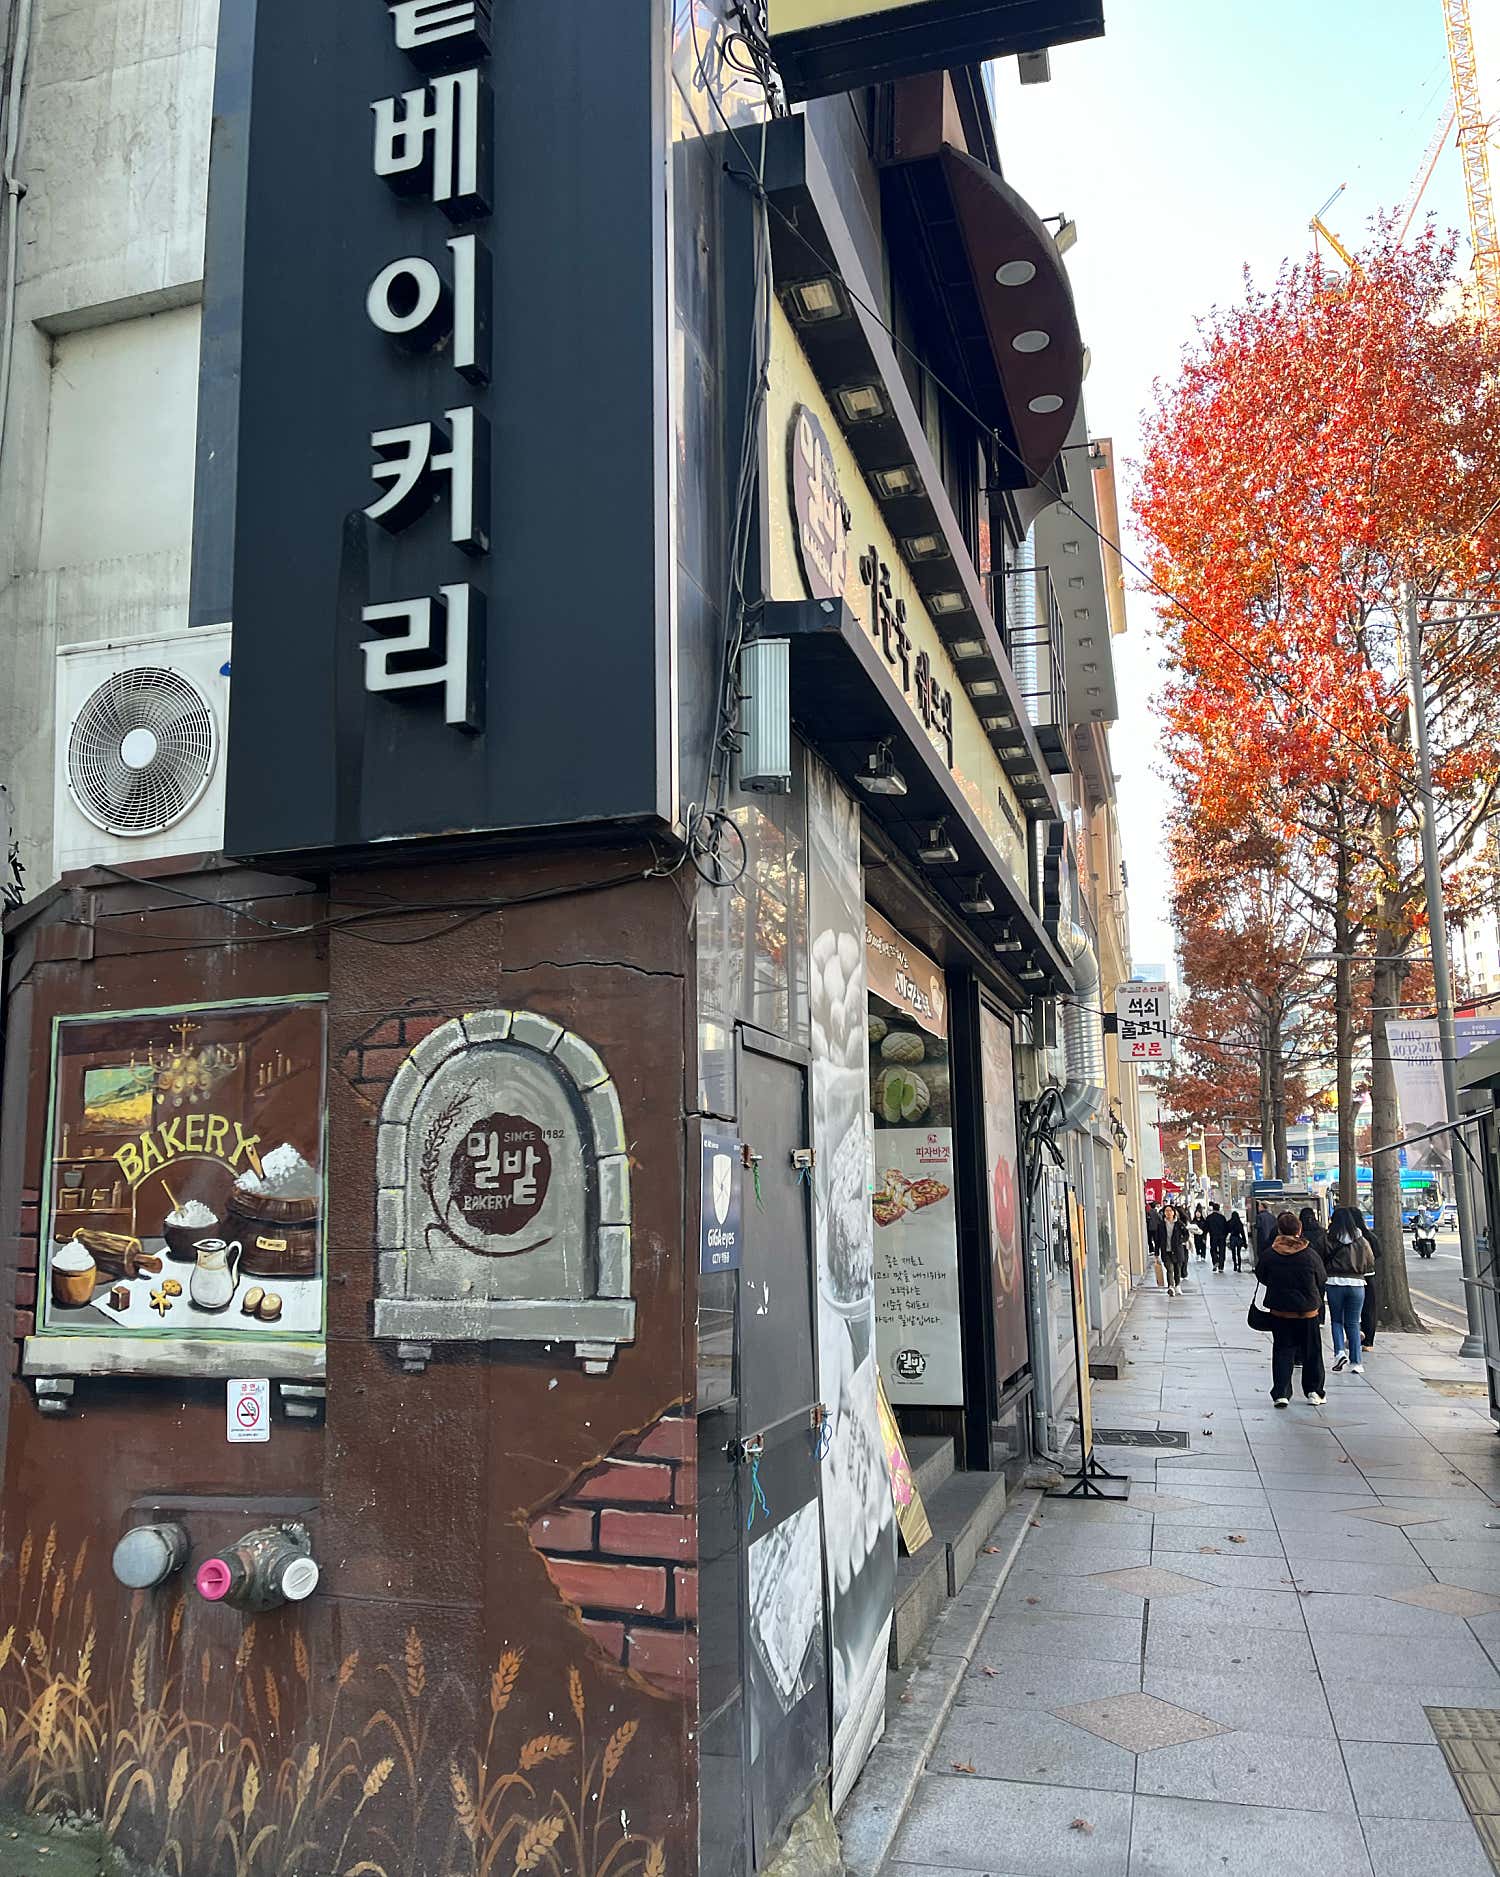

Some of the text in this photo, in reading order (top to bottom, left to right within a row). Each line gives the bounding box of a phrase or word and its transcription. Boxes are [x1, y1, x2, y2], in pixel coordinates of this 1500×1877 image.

[1128, 997, 1159, 1018] 석쇠
[1121, 1019, 1167, 1040] 불고기
[1131, 1042, 1163, 1057] 전문
[503, 1129, 566, 1142] SINCE 1982
[112, 1113, 261, 1184] BAKERY
[915, 1146, 951, 1157] 피자바겟
[466, 1131, 541, 1205] 밀밭
[462, 1194, 512, 1211] BAKERY
[899, 1351, 926, 1375] 밀밭
